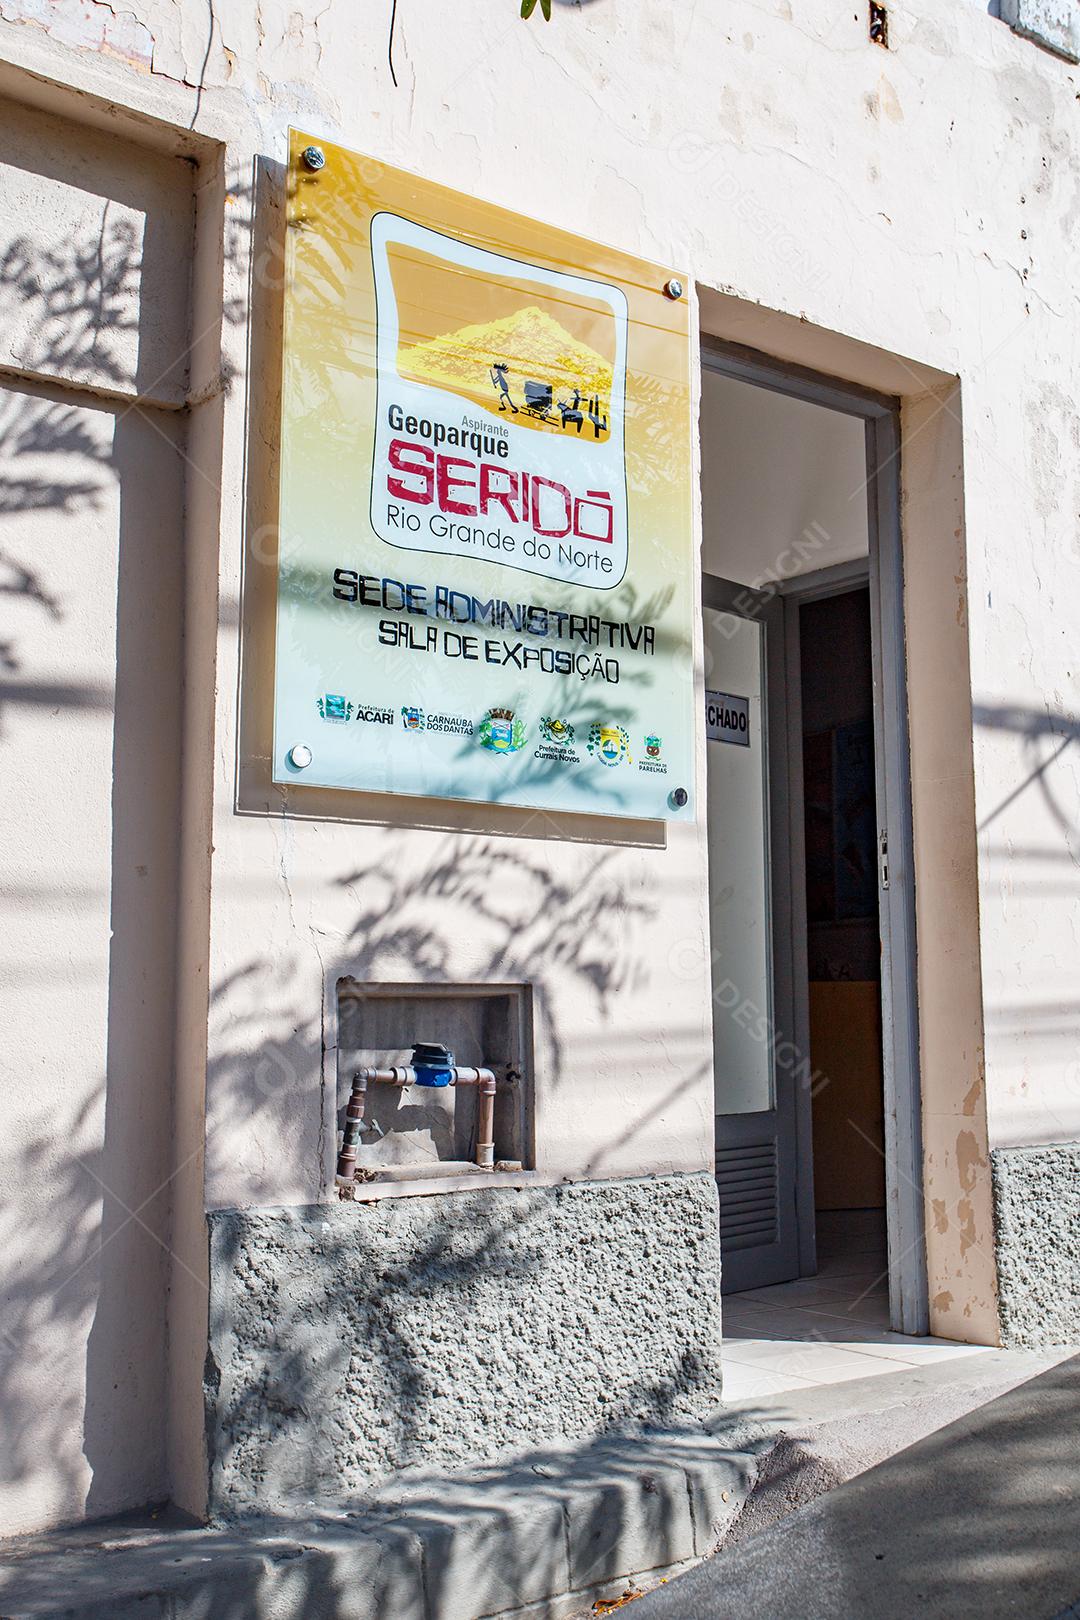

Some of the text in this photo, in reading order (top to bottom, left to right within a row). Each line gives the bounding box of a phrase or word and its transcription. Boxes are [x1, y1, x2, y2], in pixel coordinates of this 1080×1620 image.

[388, 404, 509, 459] Geoparque
[461, 415, 509, 438] Aspirante
[387, 504, 613, 573] Rio Grande do Norte
[333, 568, 428, 615] SEDE
[435, 585, 656, 656] ADMINISTRATIVA
[378, 619, 620, 684] SALA DE EXPOSIÇÃO
[358, 704, 387, 712] Prefeitura
[356, 710, 394, 725] ACARI
[427, 714, 473, 728] CARNAUBA
[705, 705, 746, 732] CHADO
[426, 722, 443, 732] DOS
[443, 725, 474, 736] DANTAS
[534, 751, 581, 763] Currais Novos
[539, 744, 567, 755] Prefeitura
[638, 765, 667, 774] PARELHAS
